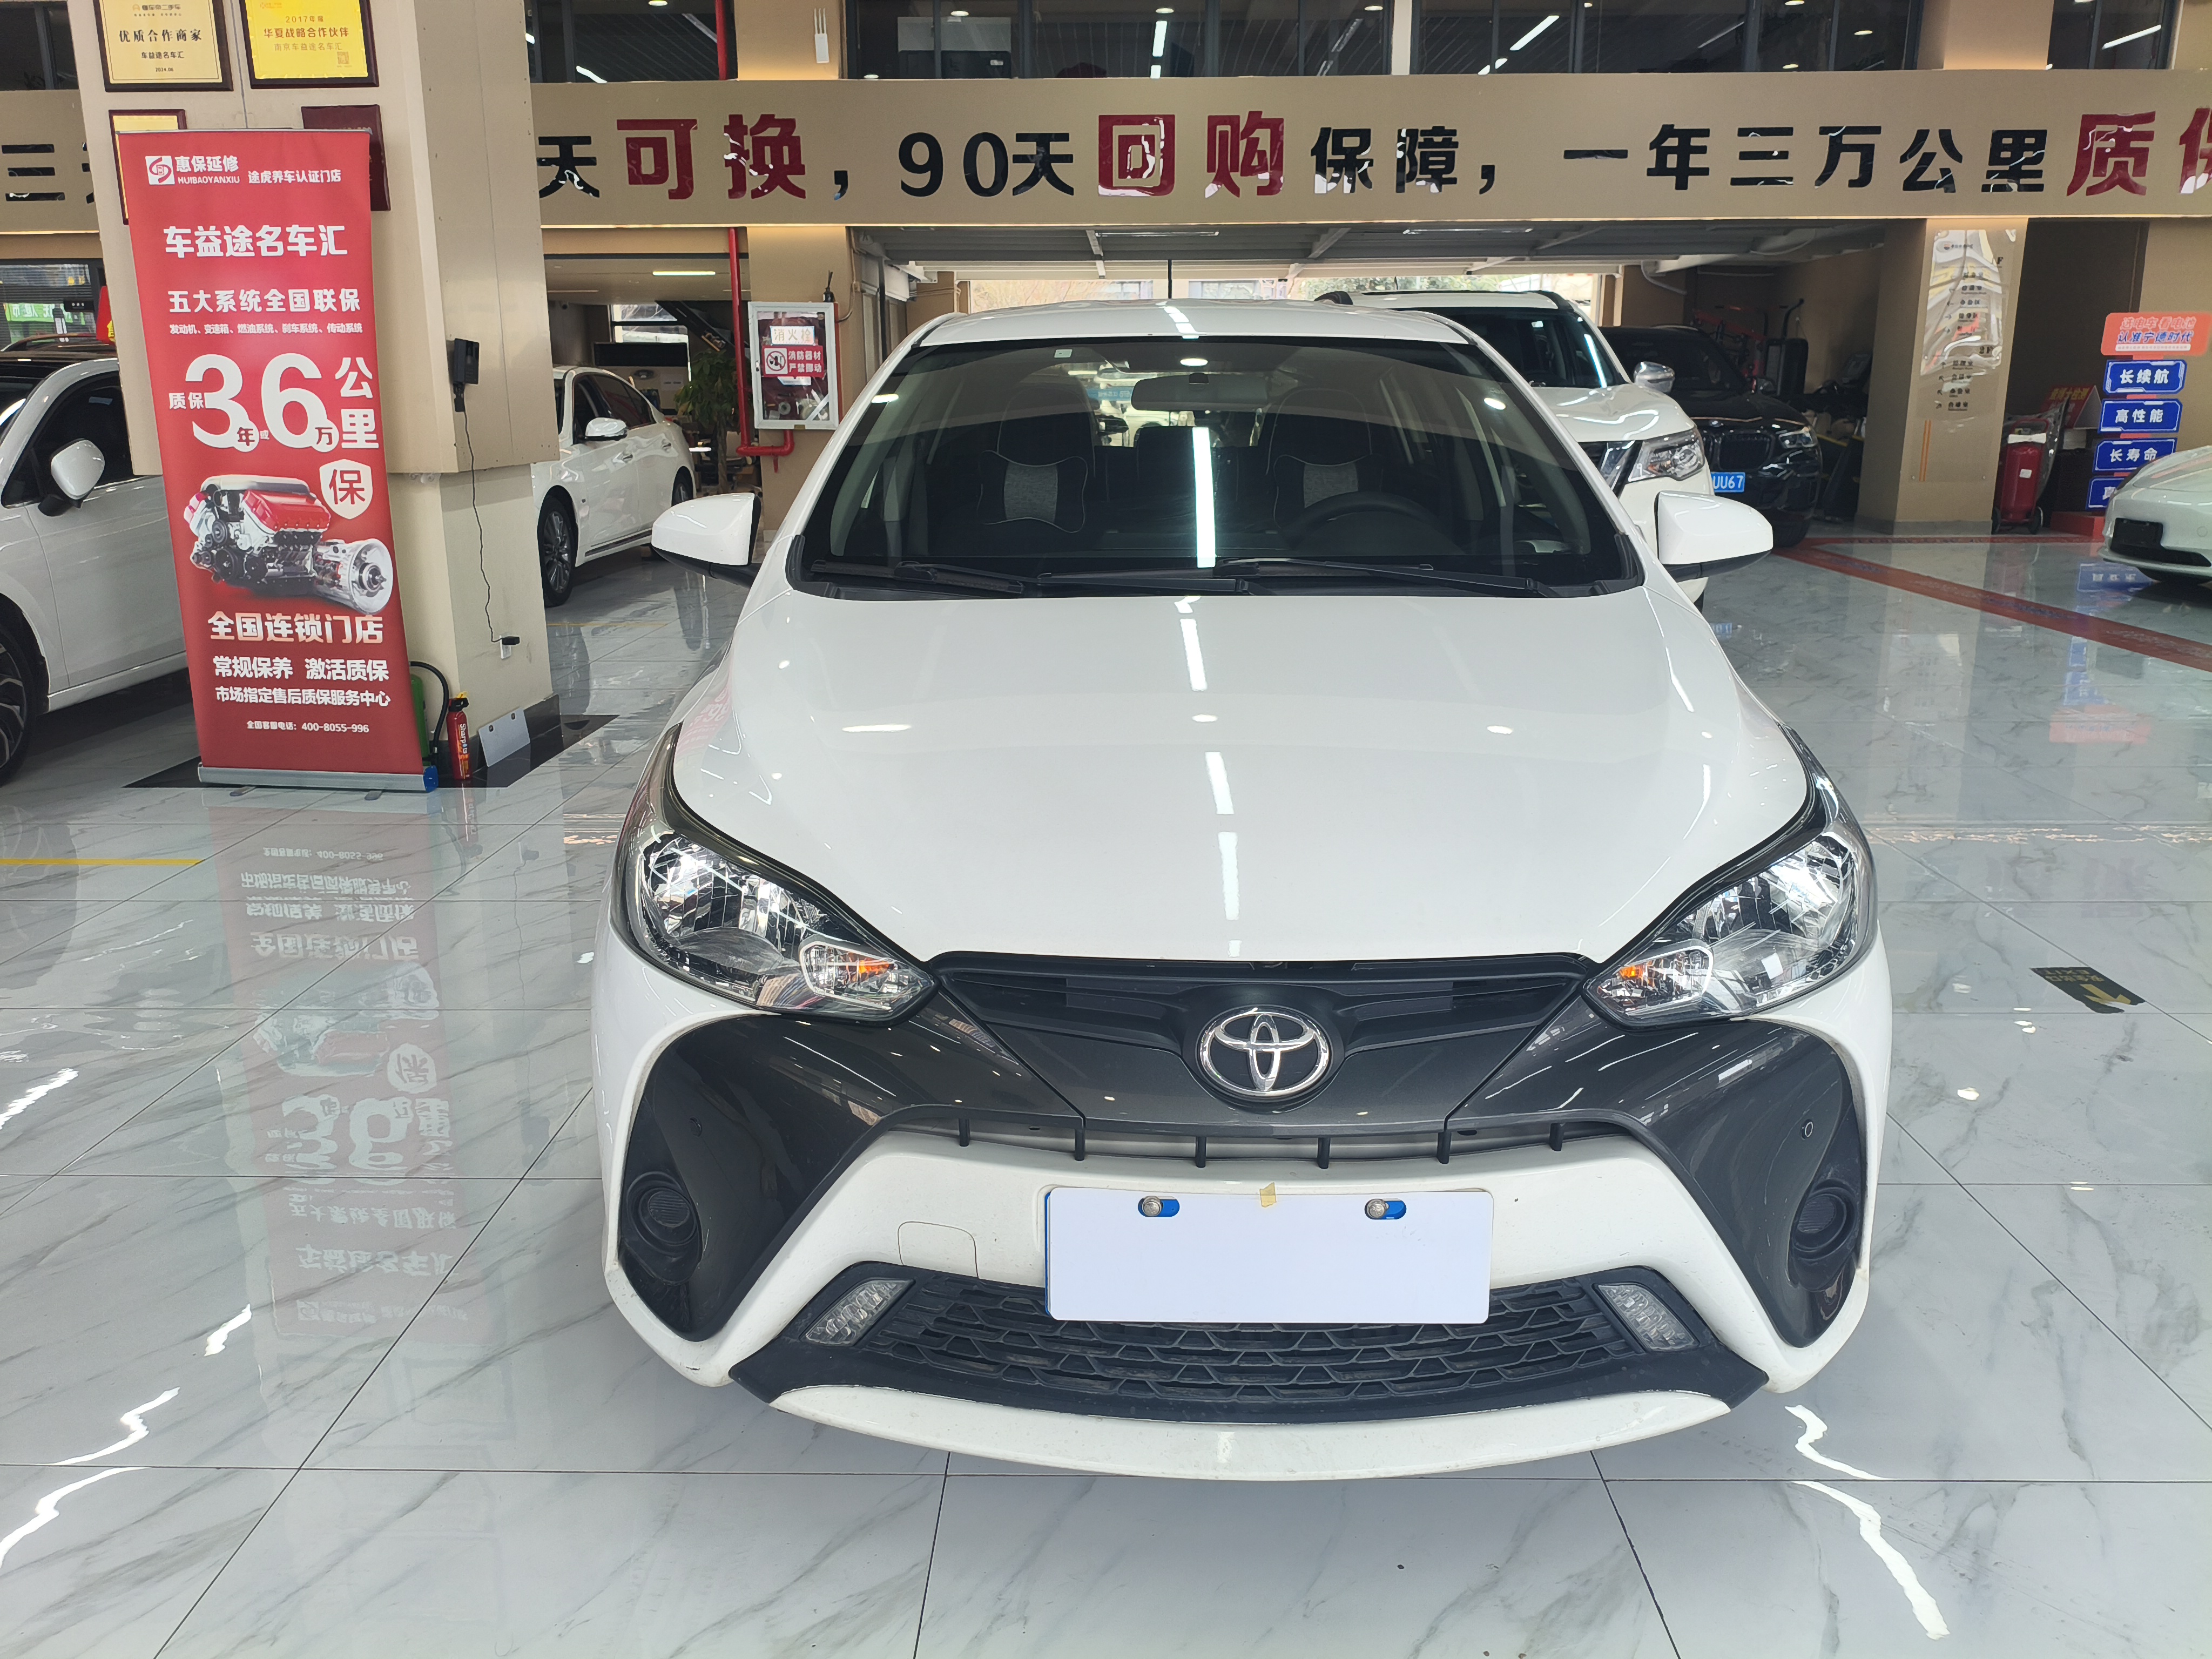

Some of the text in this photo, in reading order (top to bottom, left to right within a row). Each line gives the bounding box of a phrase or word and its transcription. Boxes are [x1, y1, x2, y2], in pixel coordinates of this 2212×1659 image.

[119, 29, 202, 42] 优质合作商家
[264, 27, 349, 38] 华夏战略合作伙伴
[274, 42, 343, 51] 南京车益途名车汇
[174, 155, 239, 172] 惠保延修
[177, 176, 240, 184] HUIBAOYANXIU
[248, 169, 342, 184] 途虎养车认证门店
[163, 224, 348, 259] 车益途名车汇
[167, 288, 361, 313] 五大系统全国联保
[774, 328, 812, 342] 消火栓
[2117, 330, 2194, 343] 认准宁德时代
[788, 350, 821, 361] 消防器材
[2120, 369, 2169, 385] 长续航
[168, 392, 204, 410] 质保
[237, 426, 256, 447] 年
[261, 353, 328, 448] 6
[315, 427, 333, 446] 万
[2115, 409, 2163, 423] 高性能
[2109, 447, 2158, 463] 长寿命
[328, 469, 365, 505] 保
[207, 611, 384, 644] 全国连锁门店
[213, 655, 389, 682] 常规保养 激活质保
[215, 685, 391, 707] 市场指定售后质保服务中心
[301, 722, 370, 733] 400-8055-996
